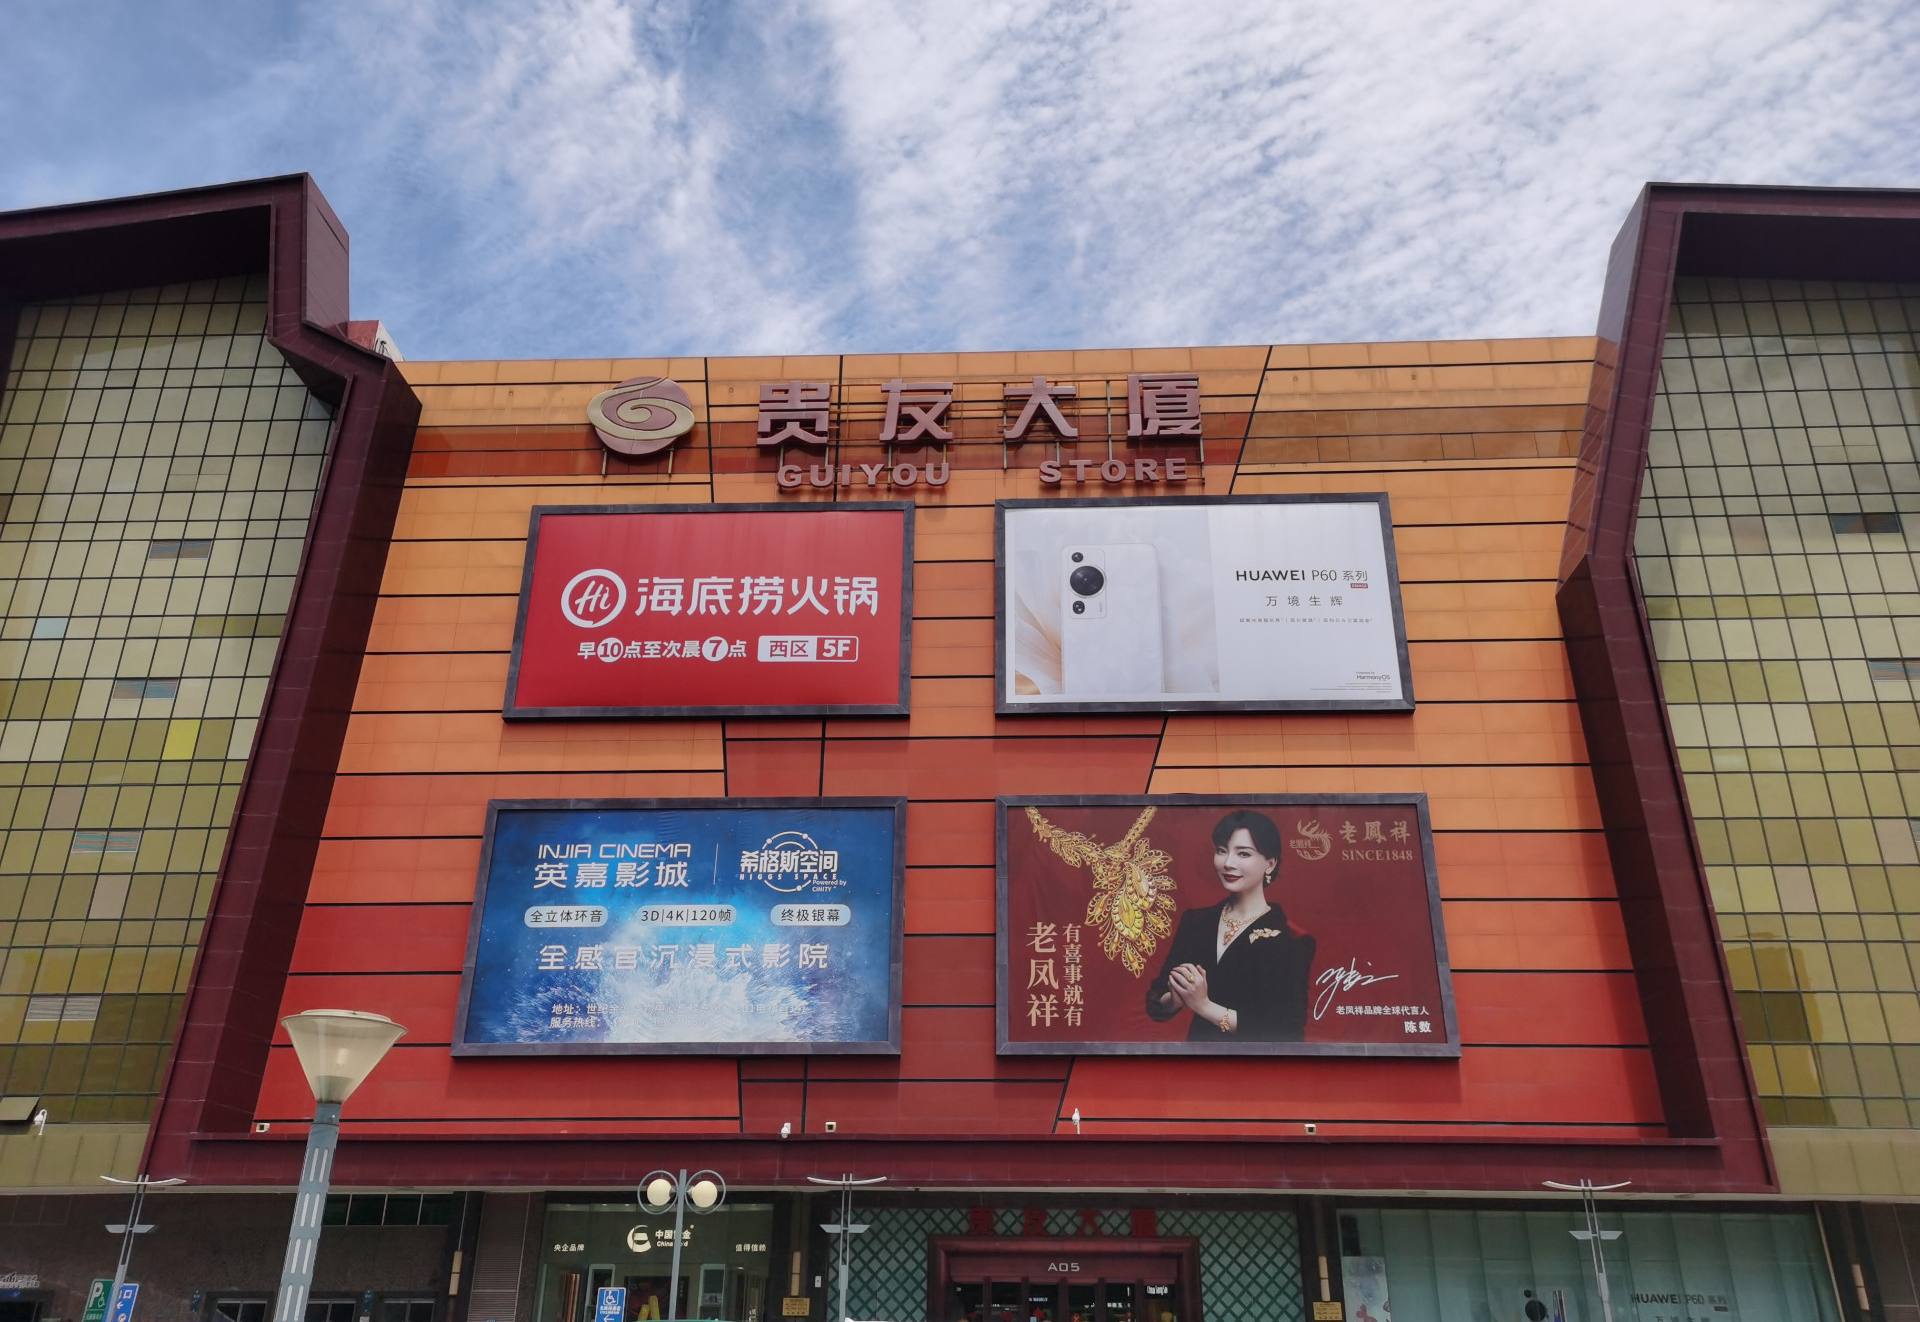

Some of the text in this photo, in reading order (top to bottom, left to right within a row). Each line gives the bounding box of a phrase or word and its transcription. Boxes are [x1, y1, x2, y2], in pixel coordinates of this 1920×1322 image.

[757, 374, 1201, 446] 贵友大厦
[777, 458, 1190, 488] GUIYOU STORE
[1236, 569, 1368, 582] HUAWEI P60 系列
[574, 580, 611, 615] Hi
[635, 576, 879, 617] 海底捞火锅
[1266, 595, 1343, 607] 万境生辉
[769, 639, 850, 658] 西区 5F
[538, 843, 691, 860] INJIA CINEMA
[740, 849, 838, 873] 希格斯空间
[533, 861, 689, 890] 英嘉影城
[739, 873, 782, 881] HIGGS
[530, 908, 603, 924] 全立体环音
[781, 907, 841, 923] 终极银幕
[538, 943, 829, 971] 全感官沉浸式影院
[1026, 921, 1059, 1028] 老凤祥
[1062, 922, 1084, 1027] 有喜事就有
[1336, 1005, 1430, 1016] 老凤祥品牌全球代言人
[1404, 1020, 1432, 1034] 陈数
[655, 1229, 691, 1240] 中国金
